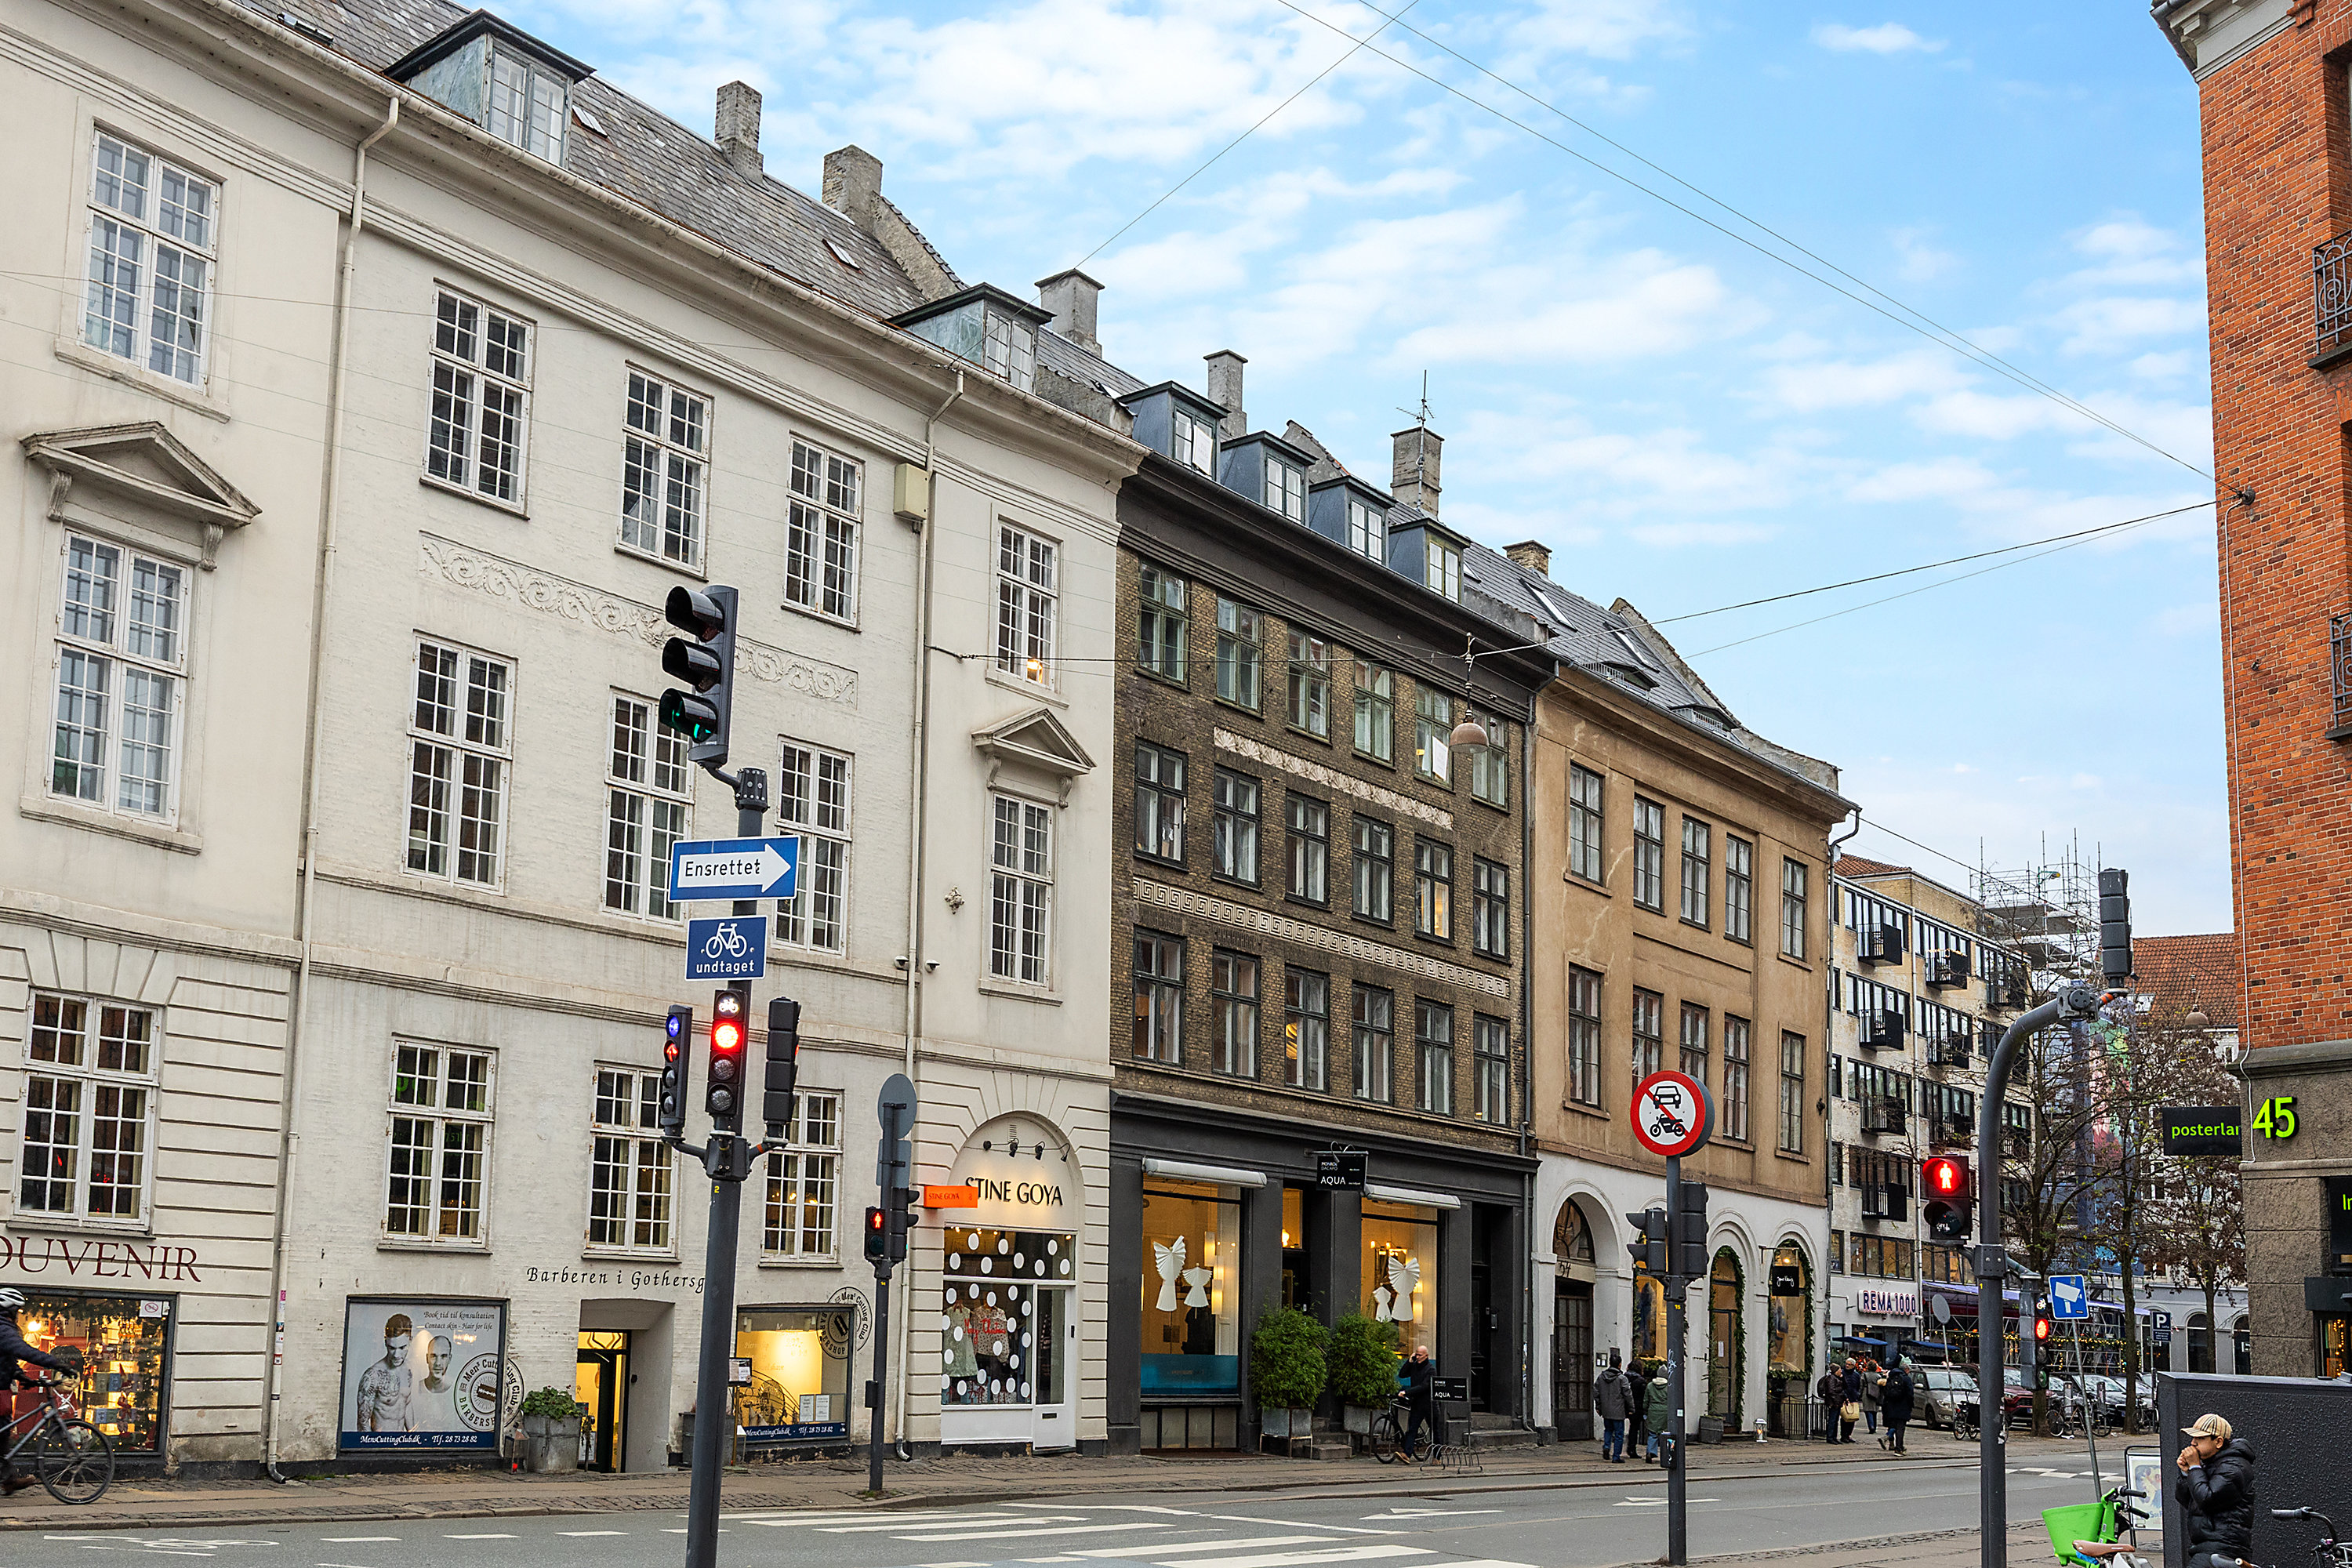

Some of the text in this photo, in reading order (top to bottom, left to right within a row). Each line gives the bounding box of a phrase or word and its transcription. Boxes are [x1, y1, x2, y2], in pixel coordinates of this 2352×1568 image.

[685, 858, 760, 877] Ensrettet
[696, 960, 754, 975] undtaget
[2252, 1097, 2296, 1138] 45
[1320, 1176, 1346, 1185] AQUA
[1017, 1182, 1063, 1207] GOYA
[526, 1266, 608, 1284] Barberen
[616, 1270, 622, 1285] i
[1864, 1290, 1916, 1315] REMA 1000
[424, 1310, 439, 1319] Book
[459, 1311, 495, 1320] konsultation
[2156, 1314, 2167, 1328] P
[446, 1322, 457, 1330] skin
[483, 1323, 492, 1331] life
[858, 1323, 869, 1340] Club
[510, 1385, 520, 1406] Club
[360, 1435, 422, 1446] MensCuttingClub.dk
[431, 1435, 445, 1446] Tlf.
